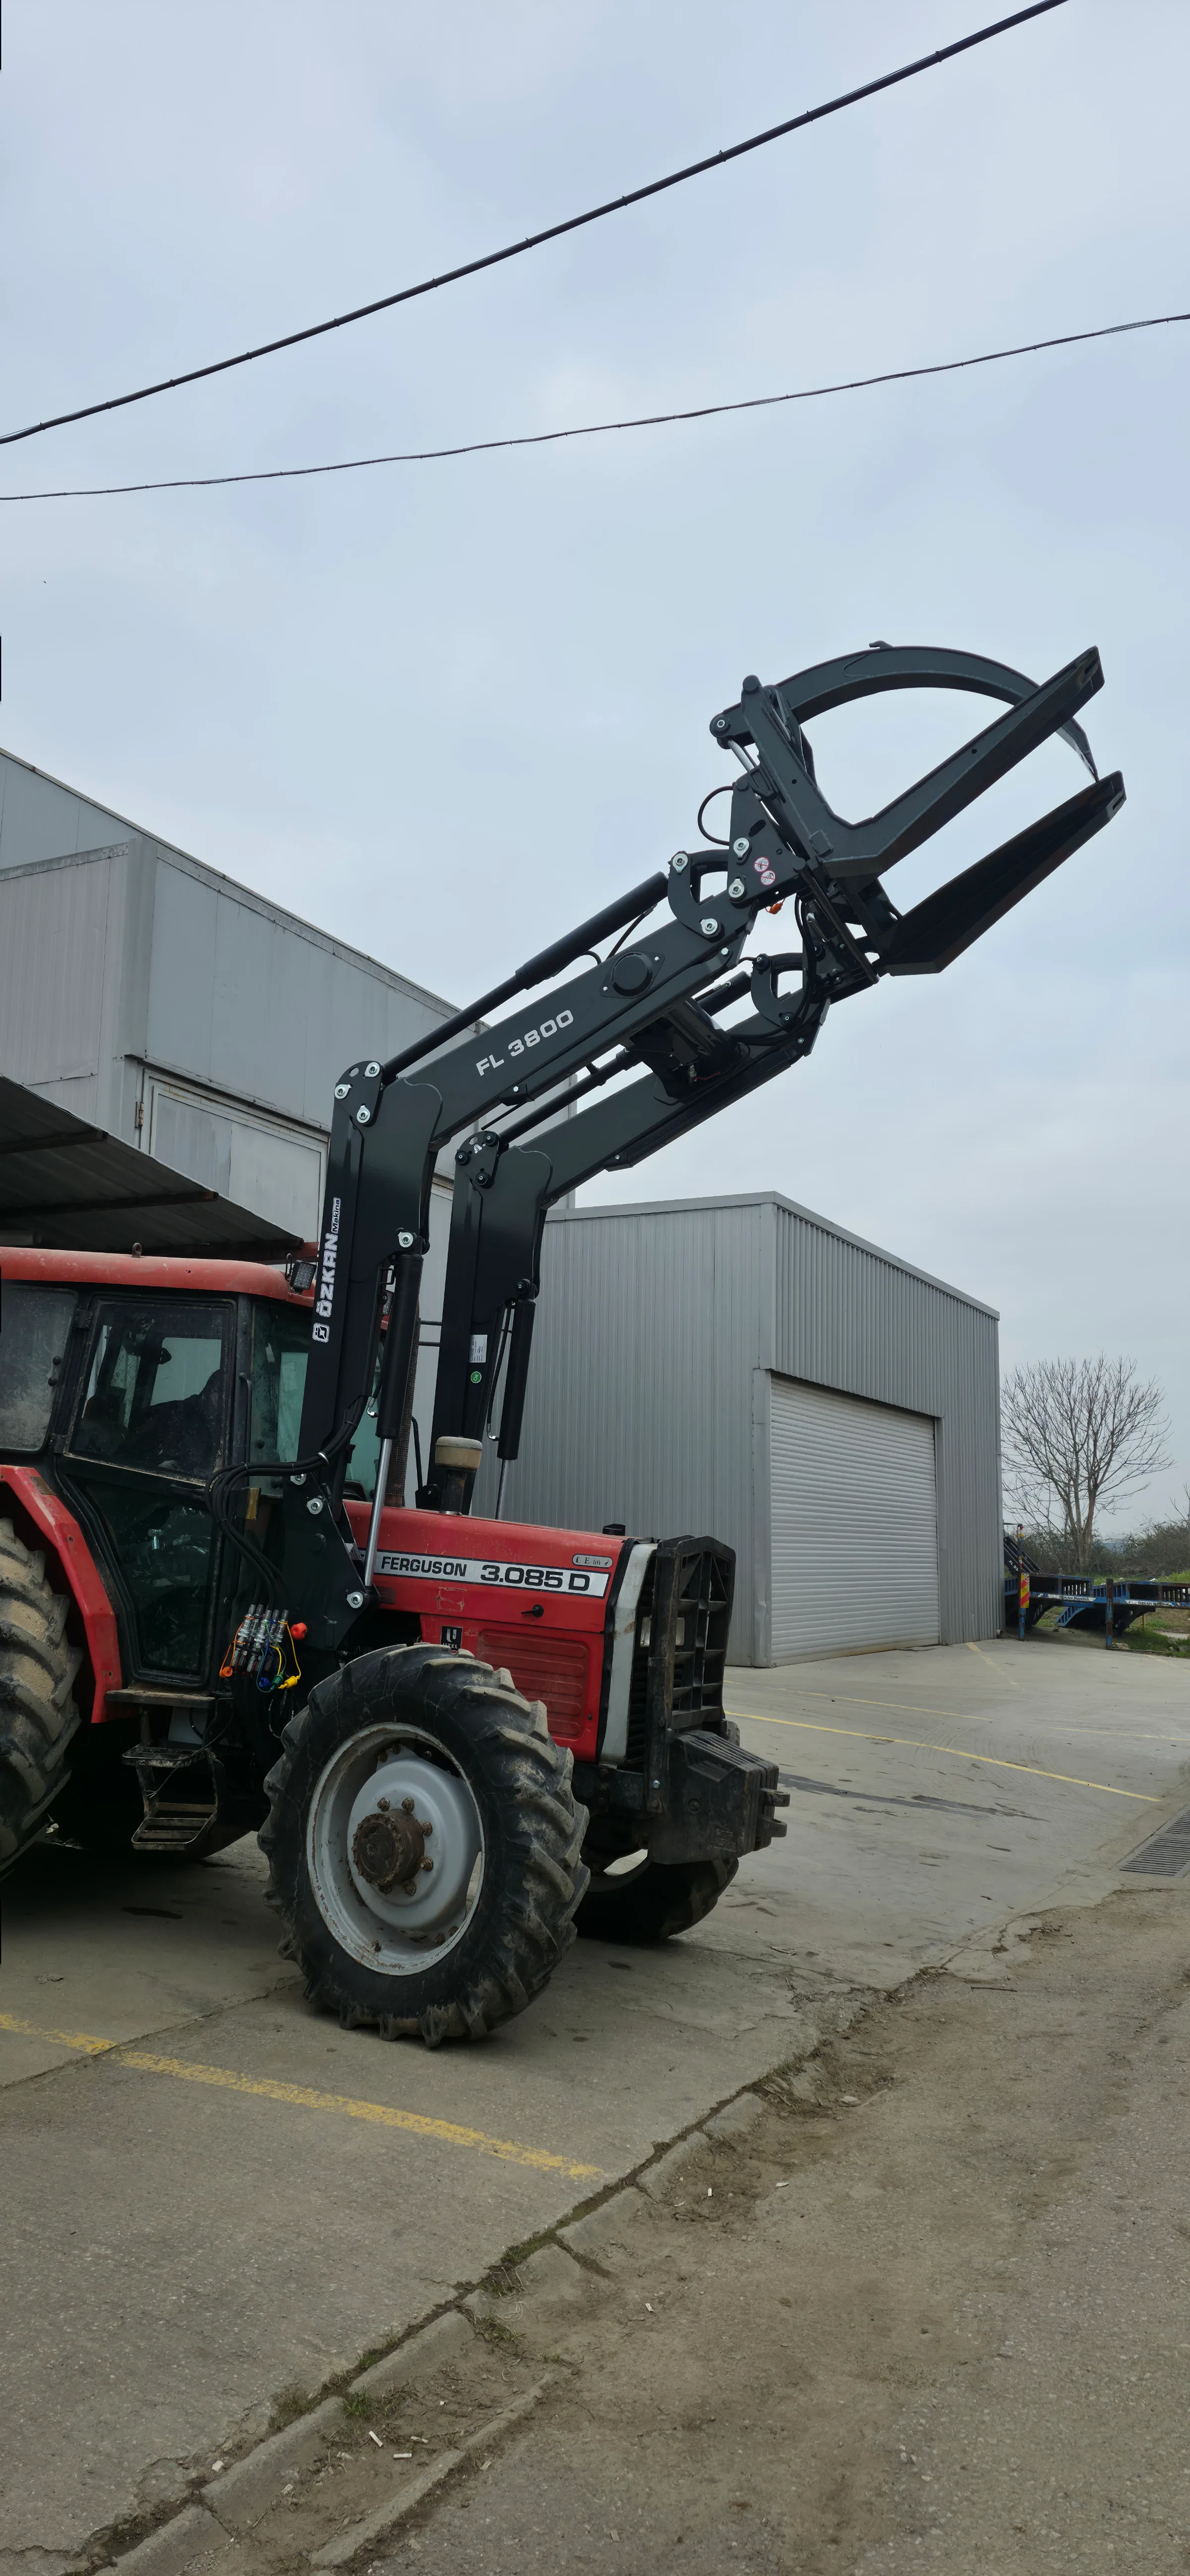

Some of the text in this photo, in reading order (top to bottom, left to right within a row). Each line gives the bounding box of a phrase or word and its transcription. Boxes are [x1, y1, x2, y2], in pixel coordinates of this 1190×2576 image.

[476, 1010, 574, 1076] FL 3800
[316, 1233, 338, 1317] ÖZKAN
[381, 1556, 467, 1577] FERGUSON
[480, 1564, 564, 1589] 3.085
[568, 1573, 591, 1592] D
[584, 1557, 601, 1565] E-lift
